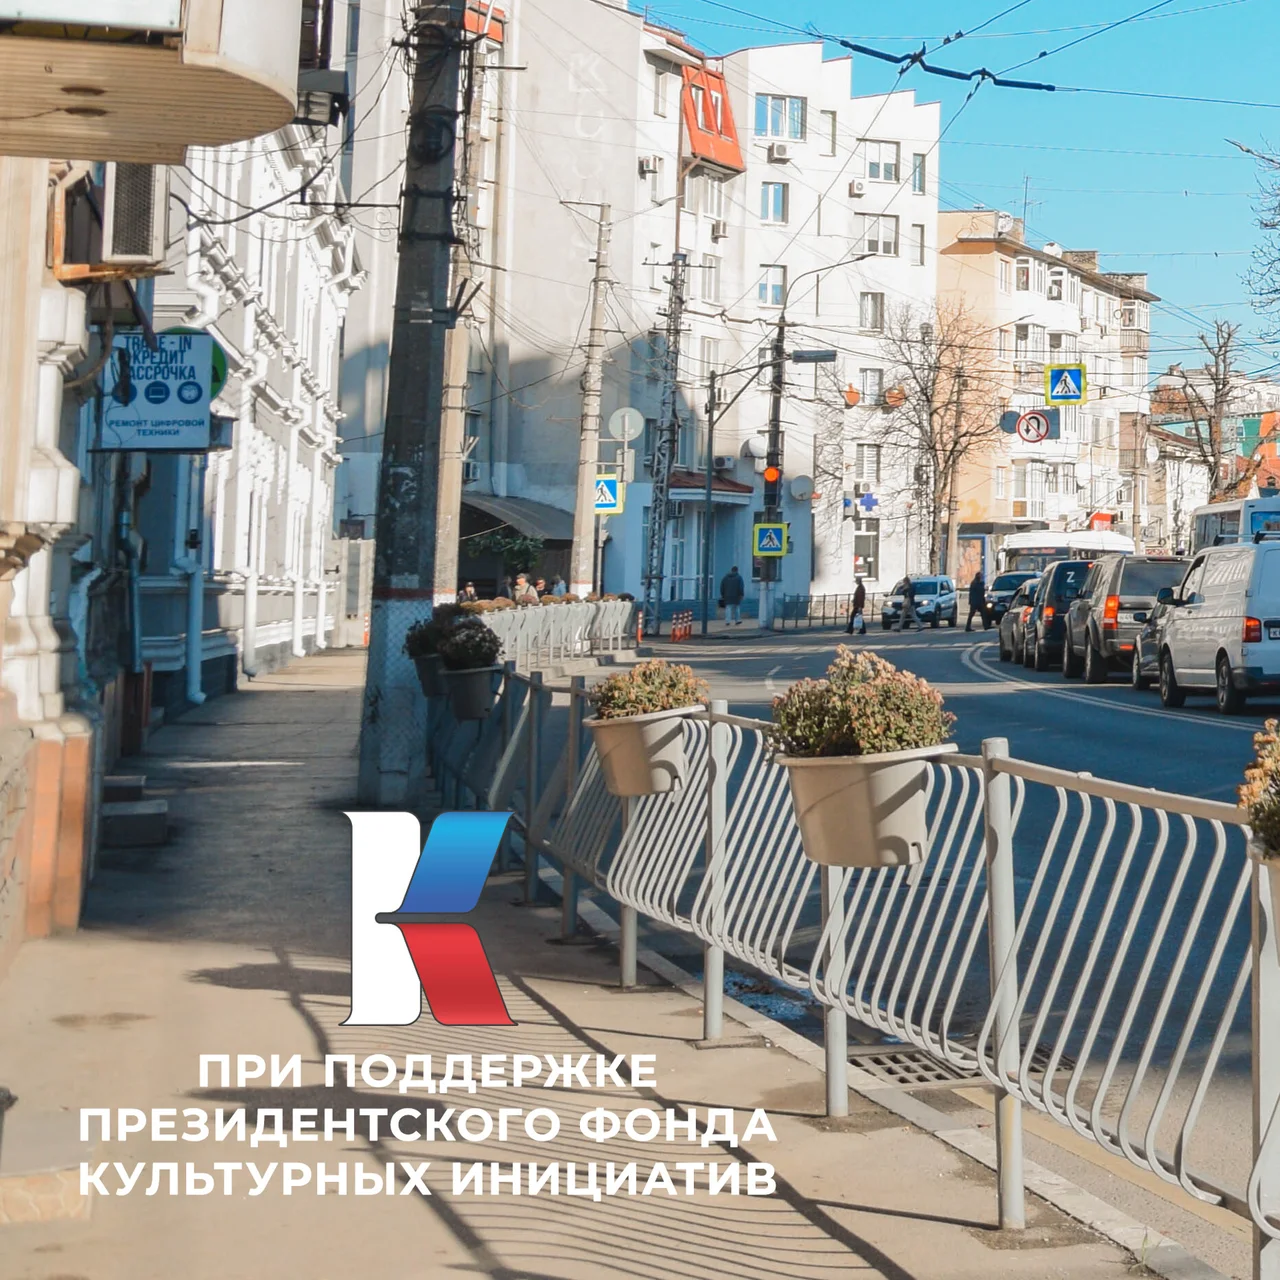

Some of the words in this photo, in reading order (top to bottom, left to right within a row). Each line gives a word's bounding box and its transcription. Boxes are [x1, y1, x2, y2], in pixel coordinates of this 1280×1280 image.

[131, 350, 187, 366] КРЕДИТ
[127, 365, 197, 380] АССРОЧКА
[110, 419, 149, 428] РЕМОНТ
[151, 419, 205, 428] ЦИФРОВОЙ
[136, 428, 181, 437] ТЕХНИКИ
[1066, 571, 1076, 583] Z
